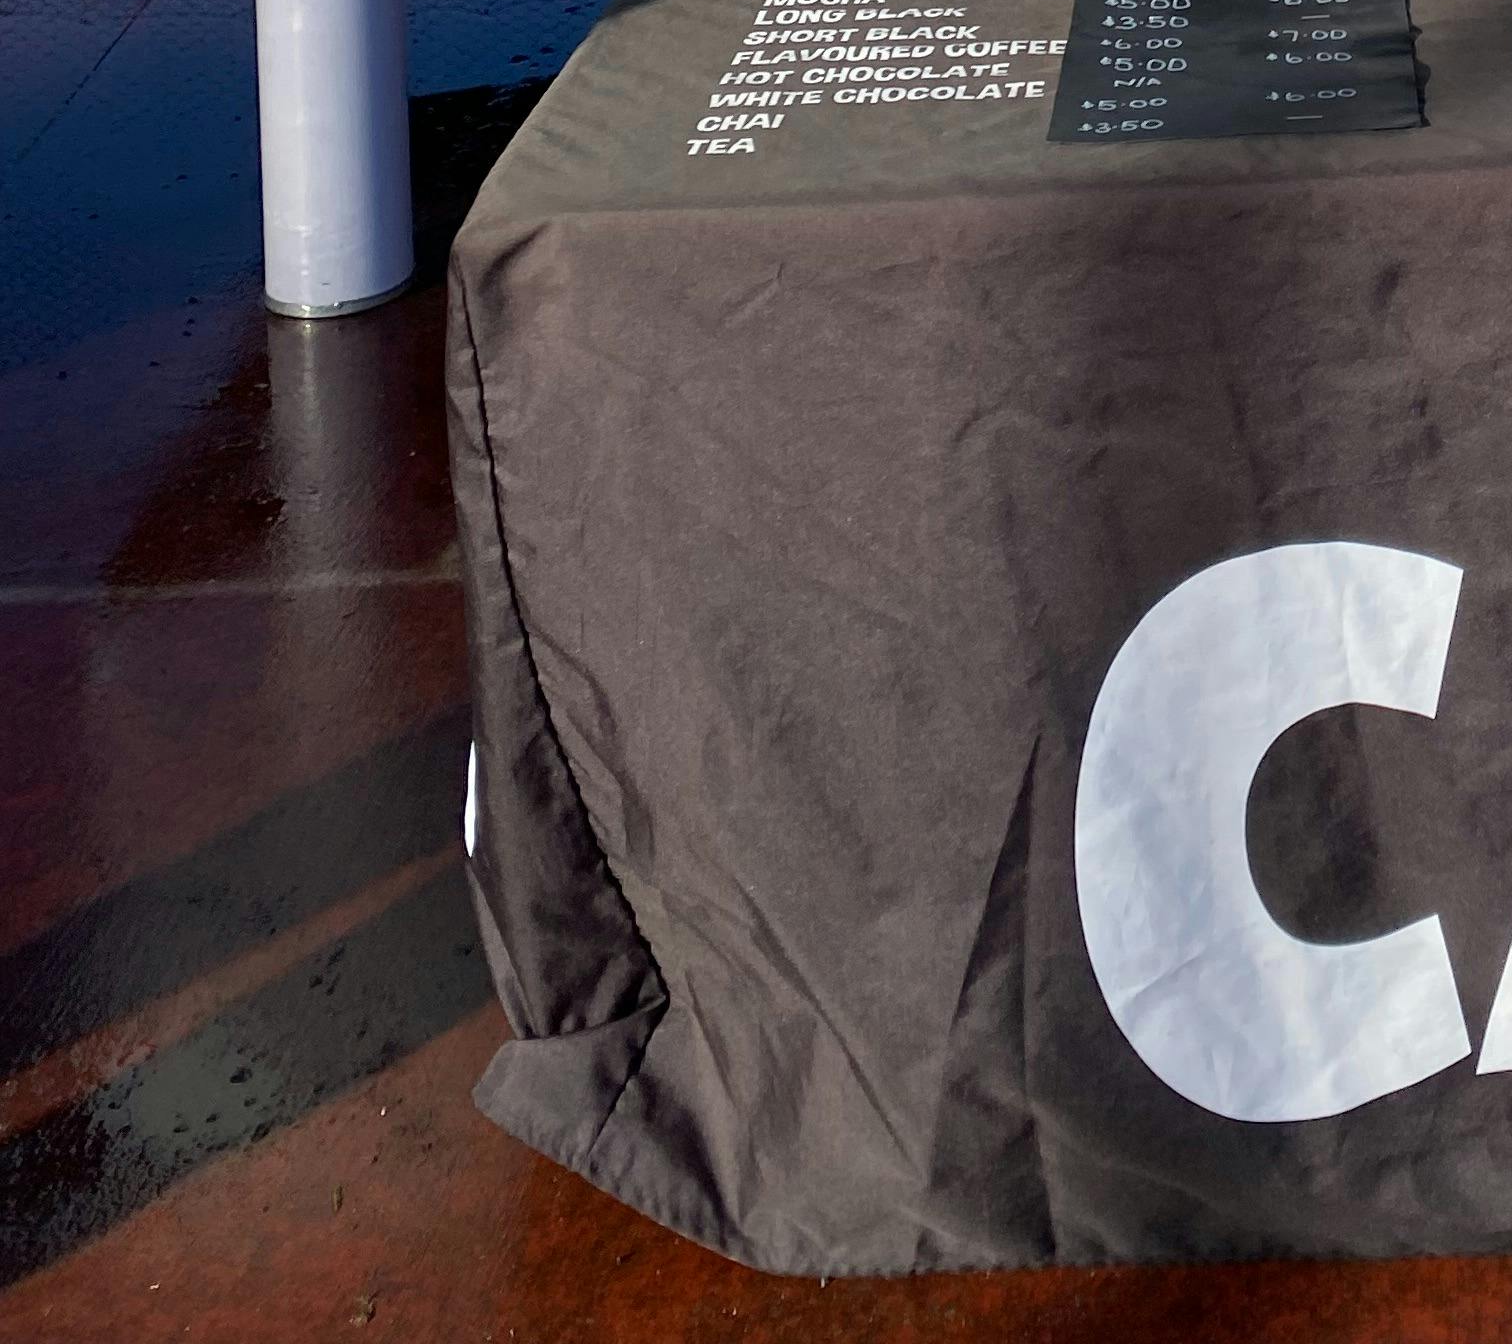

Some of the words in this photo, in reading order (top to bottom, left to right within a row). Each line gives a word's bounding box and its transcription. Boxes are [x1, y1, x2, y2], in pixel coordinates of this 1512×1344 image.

[753, 9, 848, 26] LONG
[854, 7, 968, 22] BLACK
[742, 28, 860, 46] SHORT
[864, 25, 981, 42] BLACK
[730, 45, 935, 66] FLAVOURED
[943, 39, 1069, 57] COFFEE
[718, 70, 795, 86] HOT
[801, 62, 1011, 85] CHOCOLATE
[1113, 76, 1162, 88] N/A
[708, 89, 824, 109] WHITE
[832, 80, 1047, 104] CHOCOLATE
[696, 113, 786, 132] CHAI
[686, 137, 756, 156] TEA
